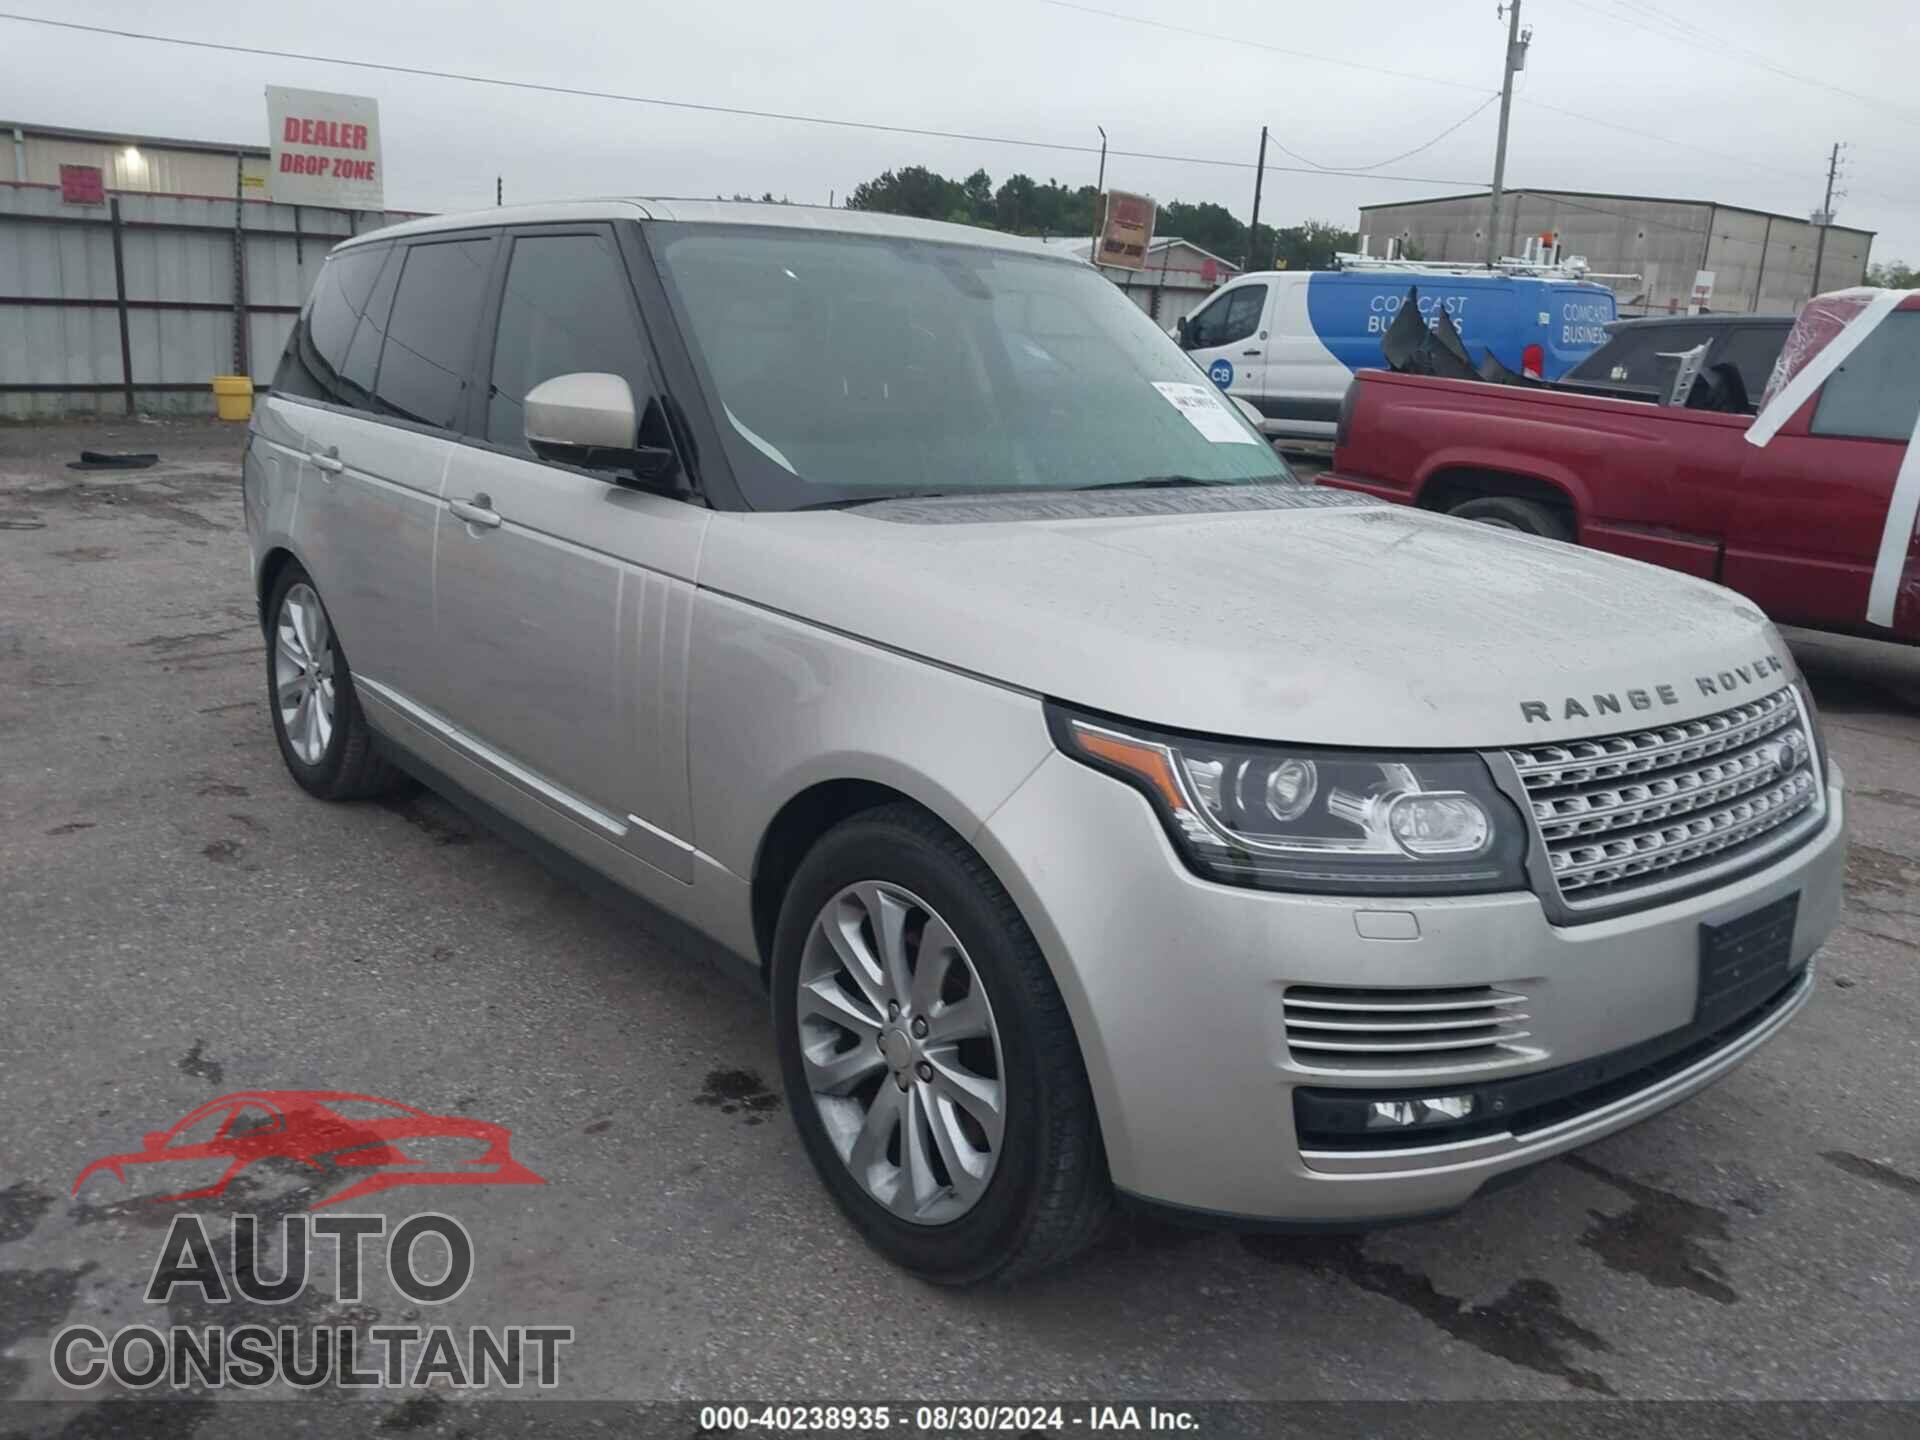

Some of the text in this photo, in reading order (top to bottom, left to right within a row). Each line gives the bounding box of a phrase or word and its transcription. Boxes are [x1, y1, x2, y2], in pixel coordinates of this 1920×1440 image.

[284, 116, 368, 150] DEALER
[280, 152, 376, 181] DROP ZONE
[1211, 368, 1230, 383] CB
[1519, 654, 1784, 723] RANGE ROVER
